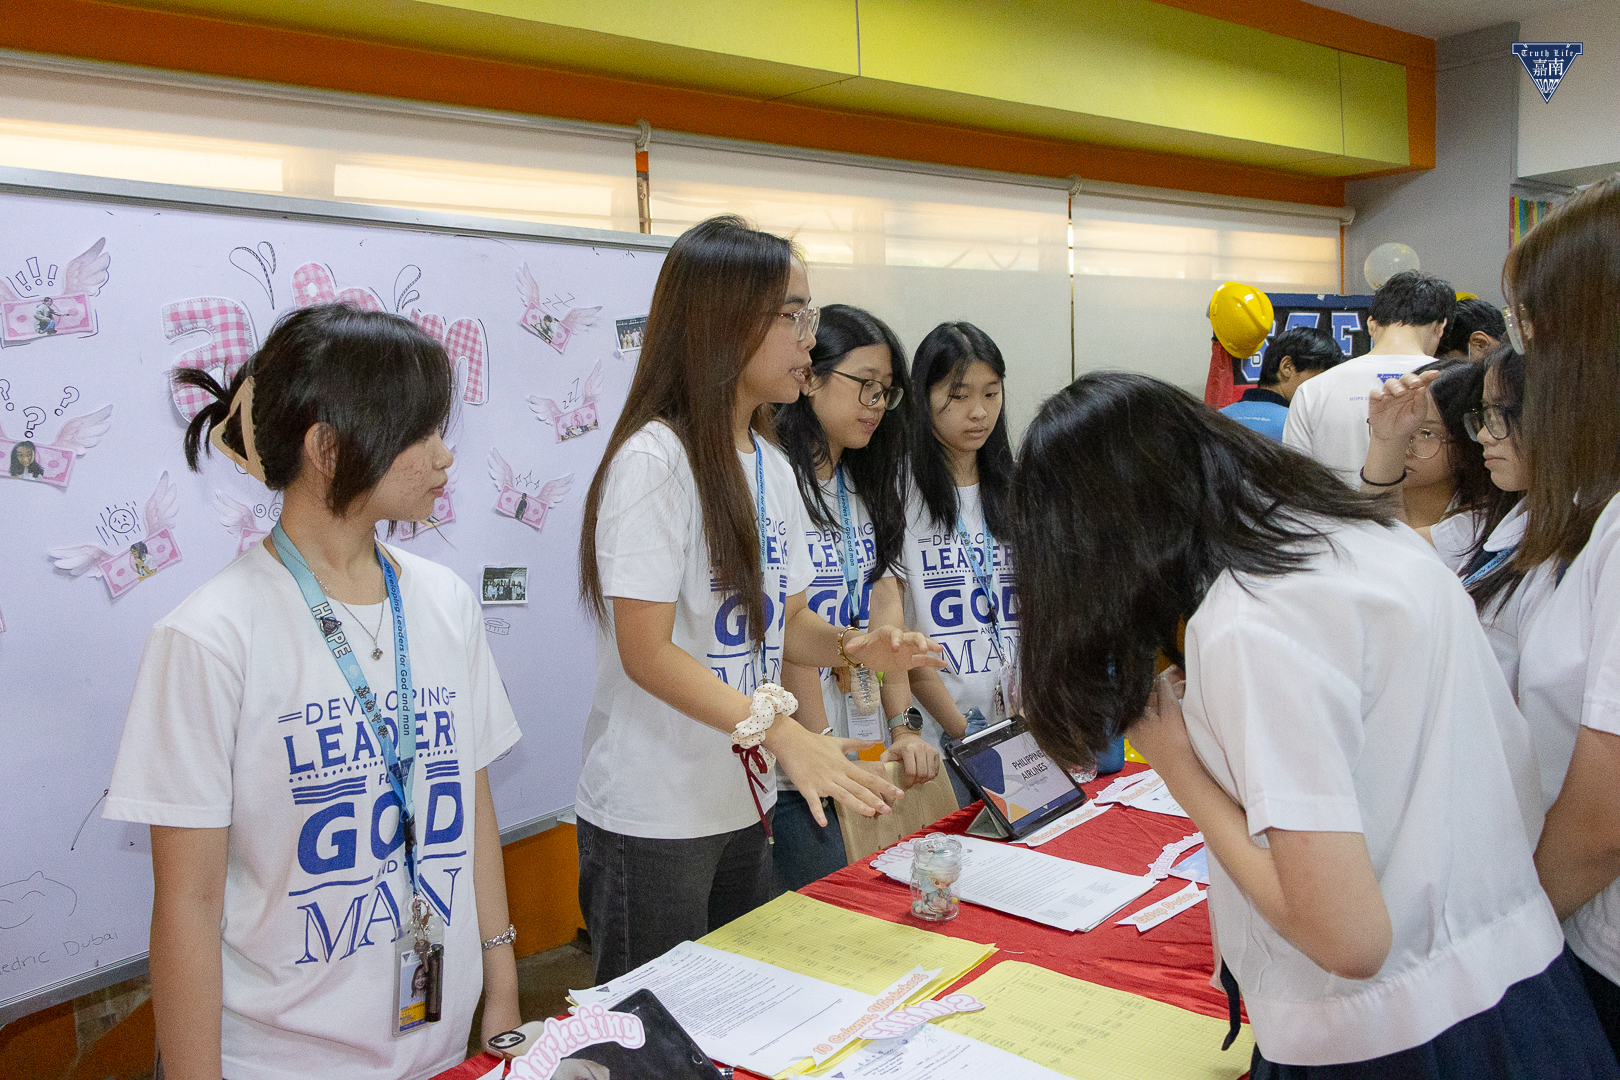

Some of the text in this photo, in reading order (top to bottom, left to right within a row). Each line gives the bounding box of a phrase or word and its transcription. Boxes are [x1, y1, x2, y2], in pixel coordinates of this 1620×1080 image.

[384, 562, 401, 613] Developing
[396, 614, 405, 652] Leaders
[400, 669, 409, 690] God
[402, 692, 411, 712] and
[402, 715, 410, 736] man
[1012, 749, 1045, 770] PHILIPPINE
[1021, 762, 1048, 780] AIRLINES
[297, 782, 464, 875] GOD
[295, 867, 461, 964] MAN
[0, 932, 119, 975] edric Dubai
[813, 1043, 834, 1055] 10
[828, 1012, 879, 1044] Column
[867, 973, 930, 1014] Worksheet
